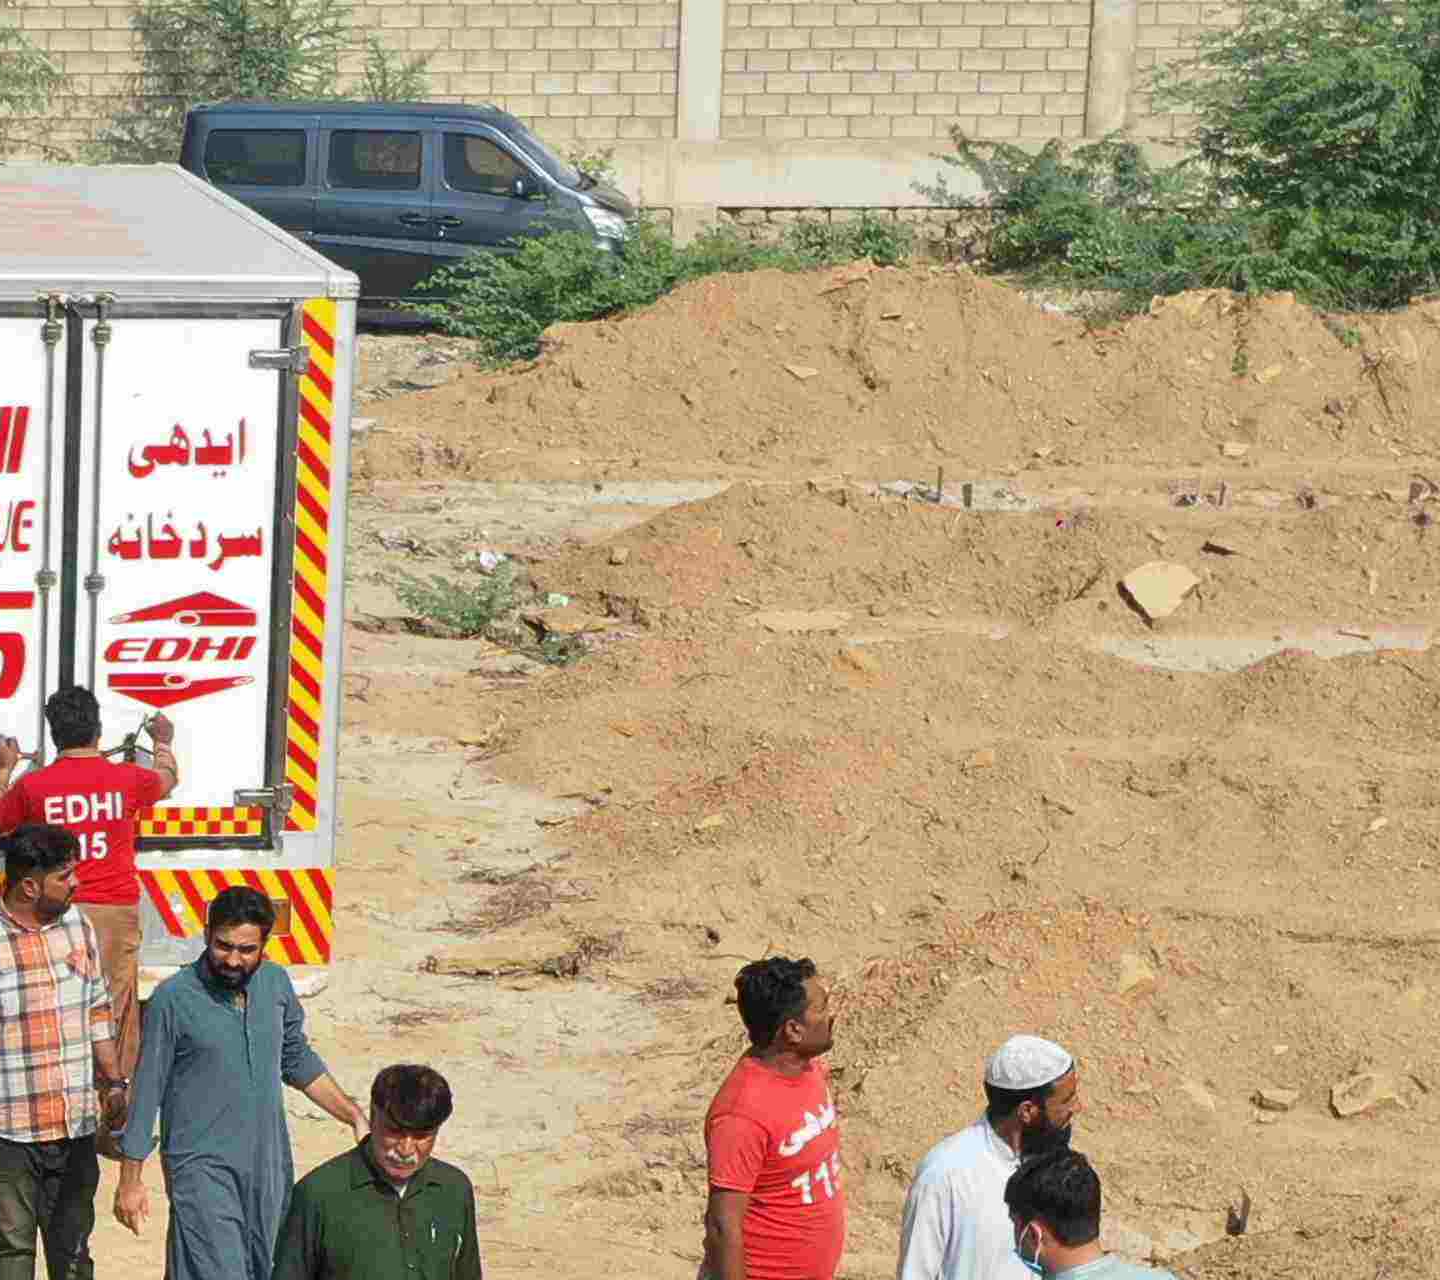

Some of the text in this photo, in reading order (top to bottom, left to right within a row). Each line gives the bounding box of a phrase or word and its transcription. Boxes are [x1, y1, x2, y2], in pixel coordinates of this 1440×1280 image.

[103, 637, 257, 663] EDHI
[44, 792, 124, 824] EDHI
[77, 832, 109, 861] 15
